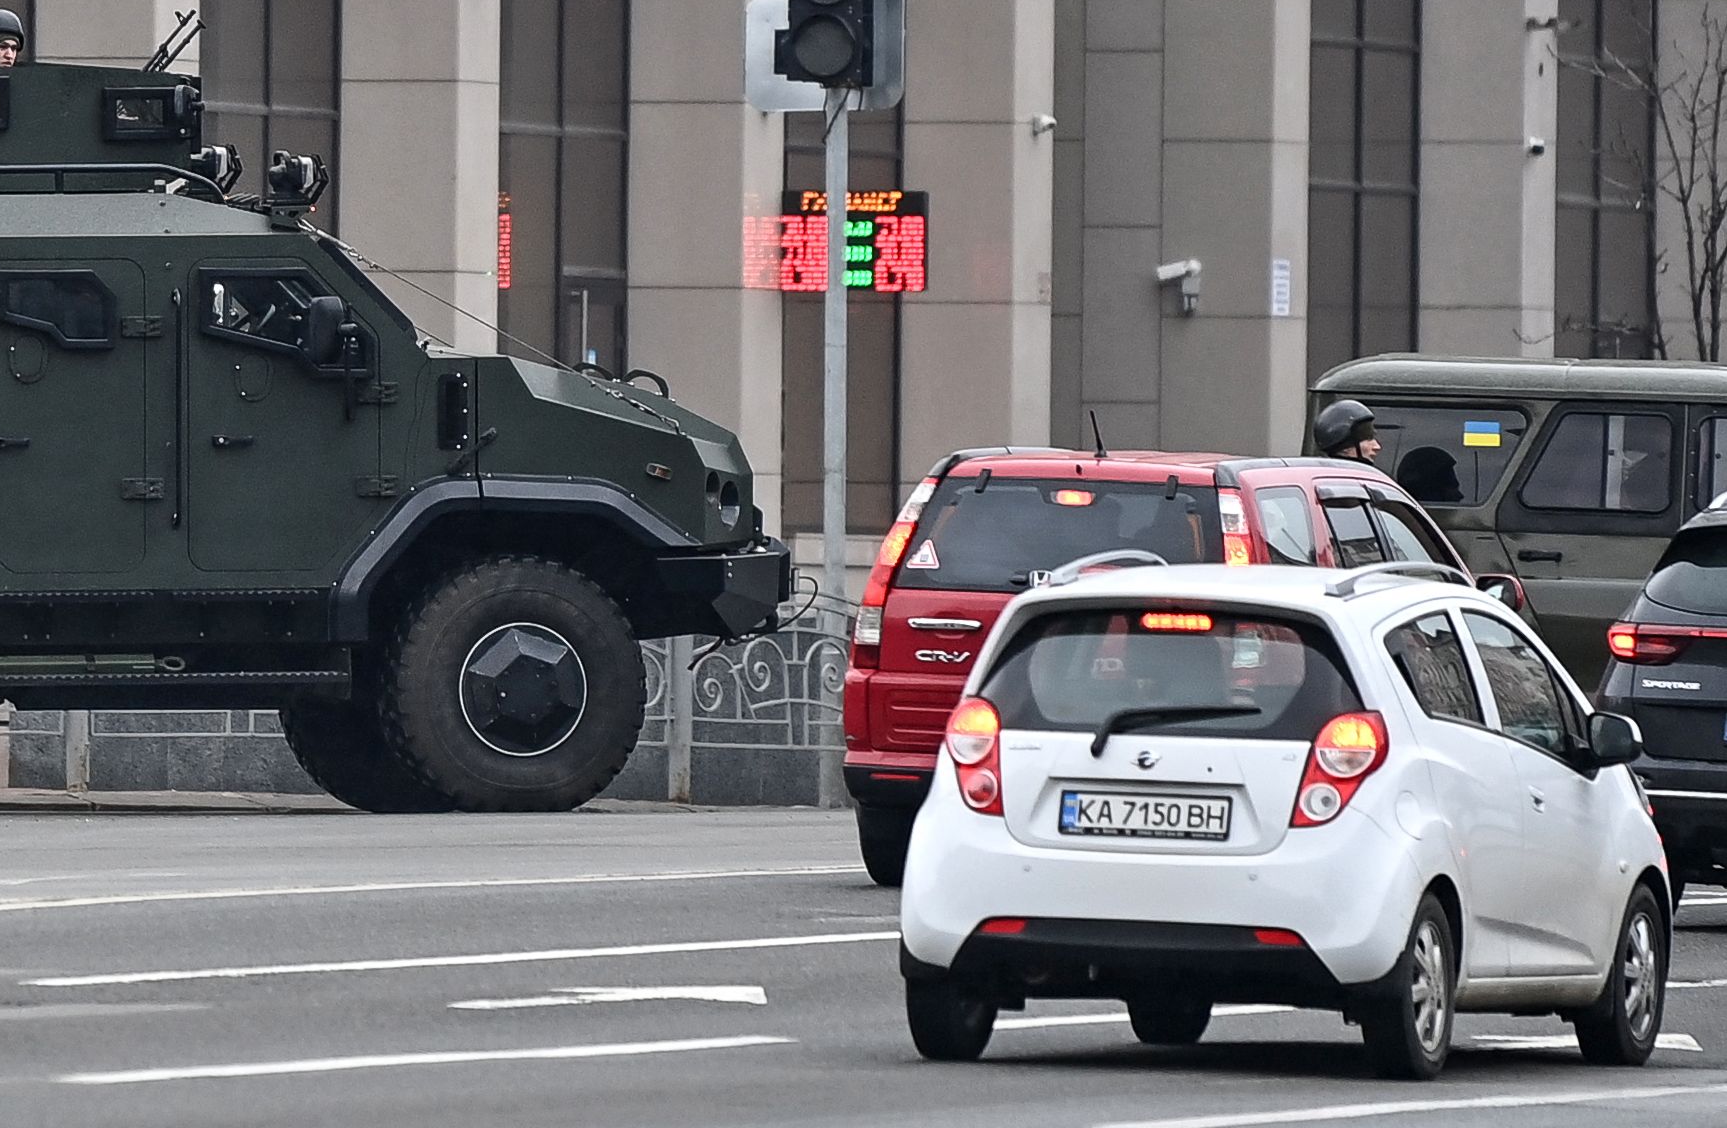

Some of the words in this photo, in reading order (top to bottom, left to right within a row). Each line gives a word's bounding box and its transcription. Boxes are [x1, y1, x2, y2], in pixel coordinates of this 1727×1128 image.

[915, 649, 971, 663] CR-V
[1078, 799, 1113, 824] KA
[1122, 800, 1181, 827] 7150
[1187, 804, 1225, 830] BH
